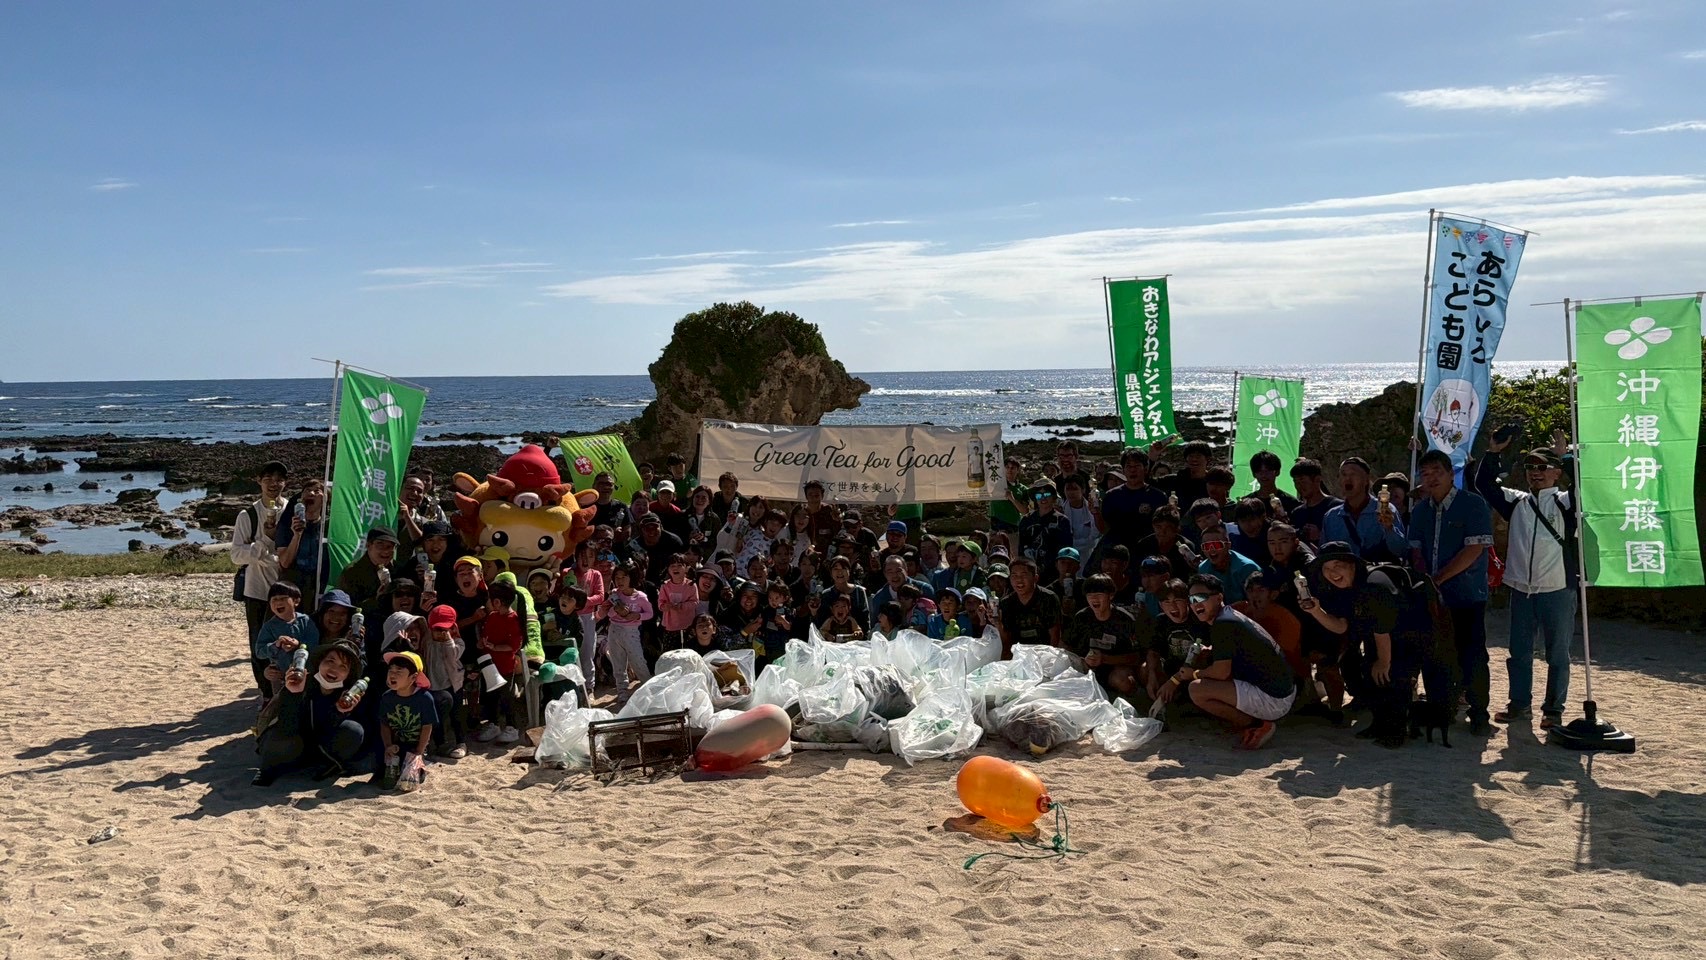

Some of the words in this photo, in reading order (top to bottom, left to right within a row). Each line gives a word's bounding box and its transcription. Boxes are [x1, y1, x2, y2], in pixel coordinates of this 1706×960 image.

[1436, 251, 1470, 371] こども園
[1125, 373, 1148, 440] 県民会議
[1142, 285, 1168, 437] おきなわアジェンダ21
[753, 442, 821, 472] Green
[823, 440, 860, 469] Tea
[862, 451, 891, 474] for
[896, 446, 956, 477] Good
[803, 481, 906, 493] で世界を美しく。
[1614, 369, 1666, 574] 沖縄伊藤園
